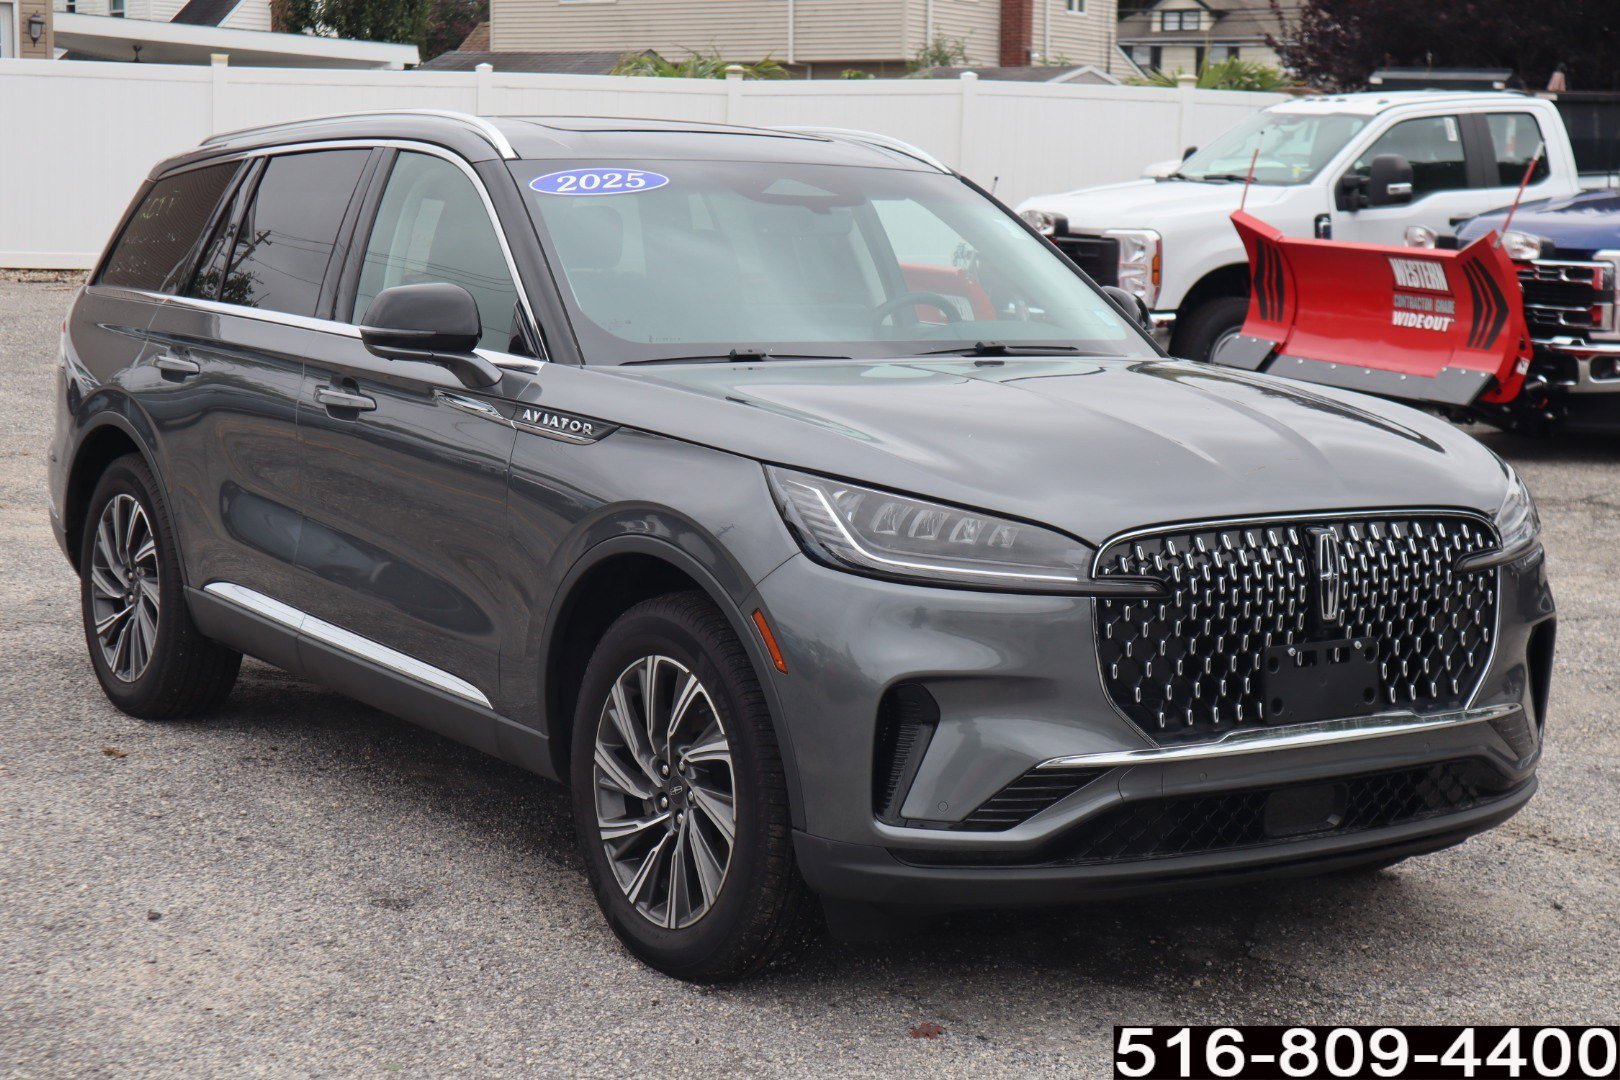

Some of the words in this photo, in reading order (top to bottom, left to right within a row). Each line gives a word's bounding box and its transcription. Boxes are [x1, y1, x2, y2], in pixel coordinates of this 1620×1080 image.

[556, 172, 646, 192] 2025
[1388, 257, 1449, 292] WESTERN
[522, 408, 593, 436] AVIATOR
